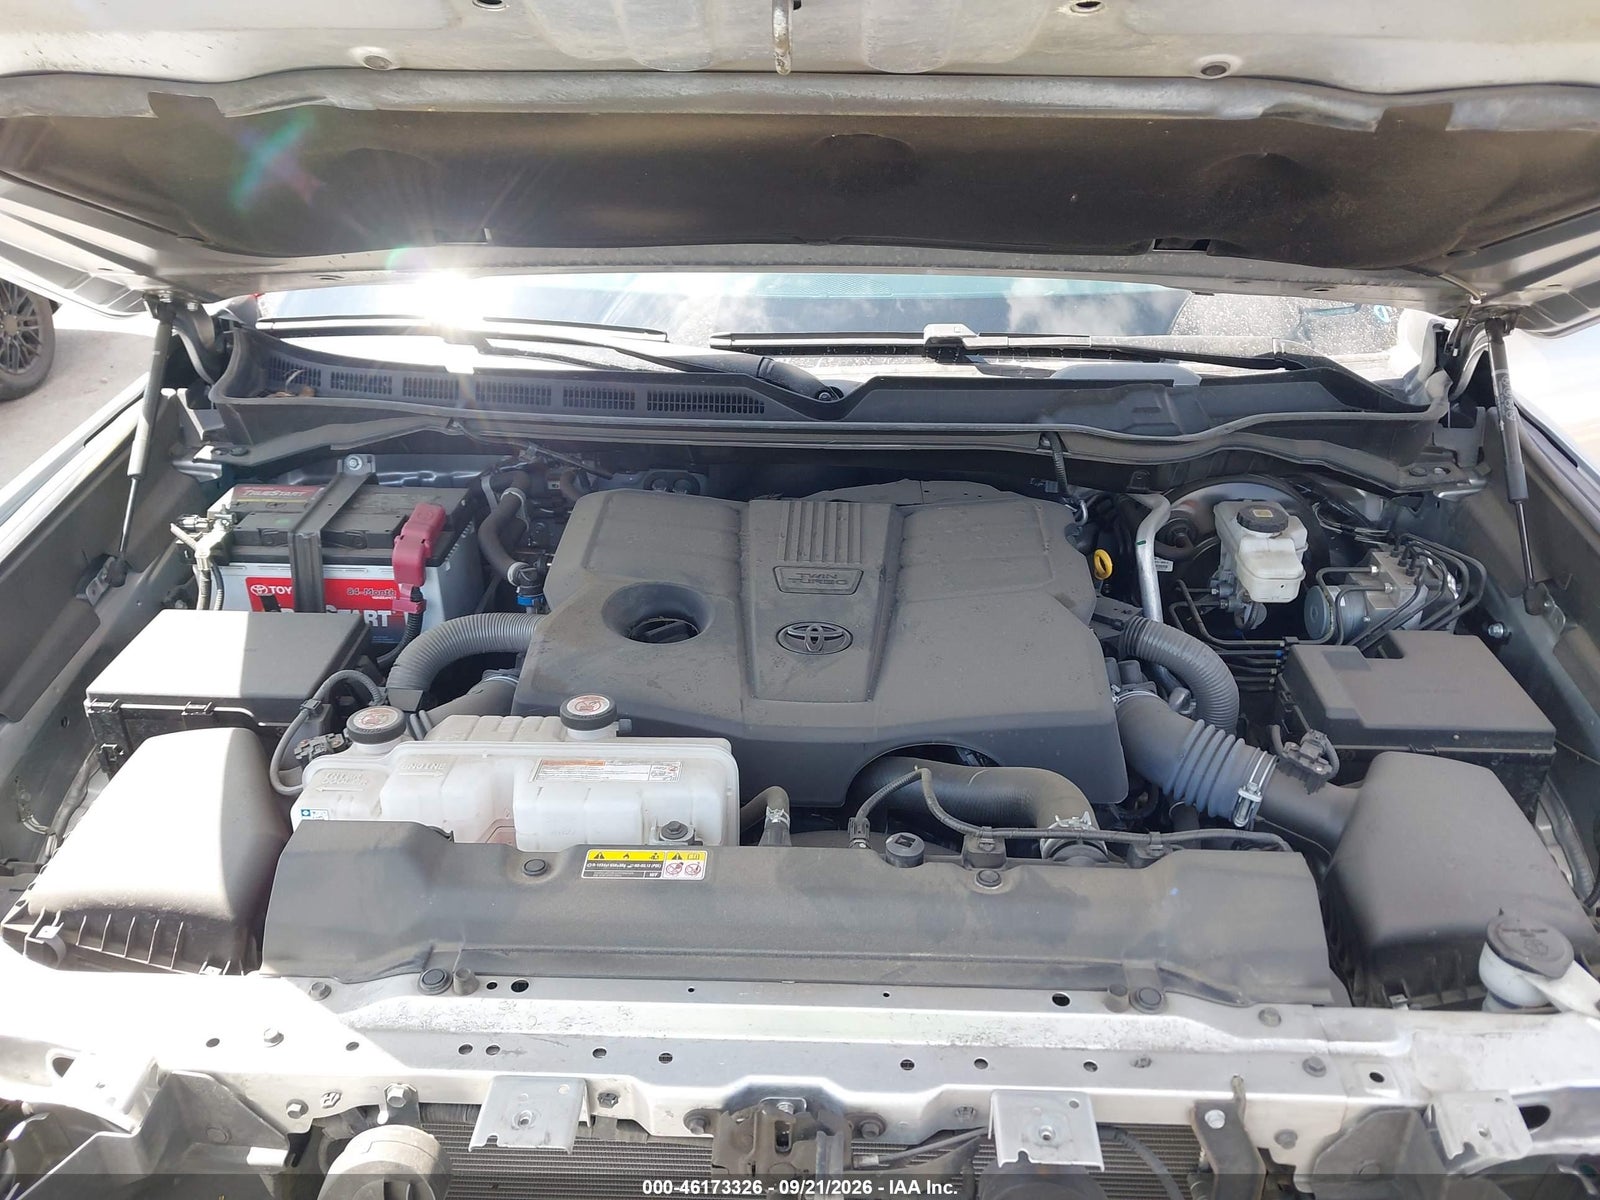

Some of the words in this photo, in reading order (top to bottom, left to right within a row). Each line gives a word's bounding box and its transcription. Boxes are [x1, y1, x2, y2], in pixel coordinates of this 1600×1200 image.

[795, 572, 838, 580] TWIN
[787, 578, 849, 586] TURBO
[269, 585, 292, 595] TOY
